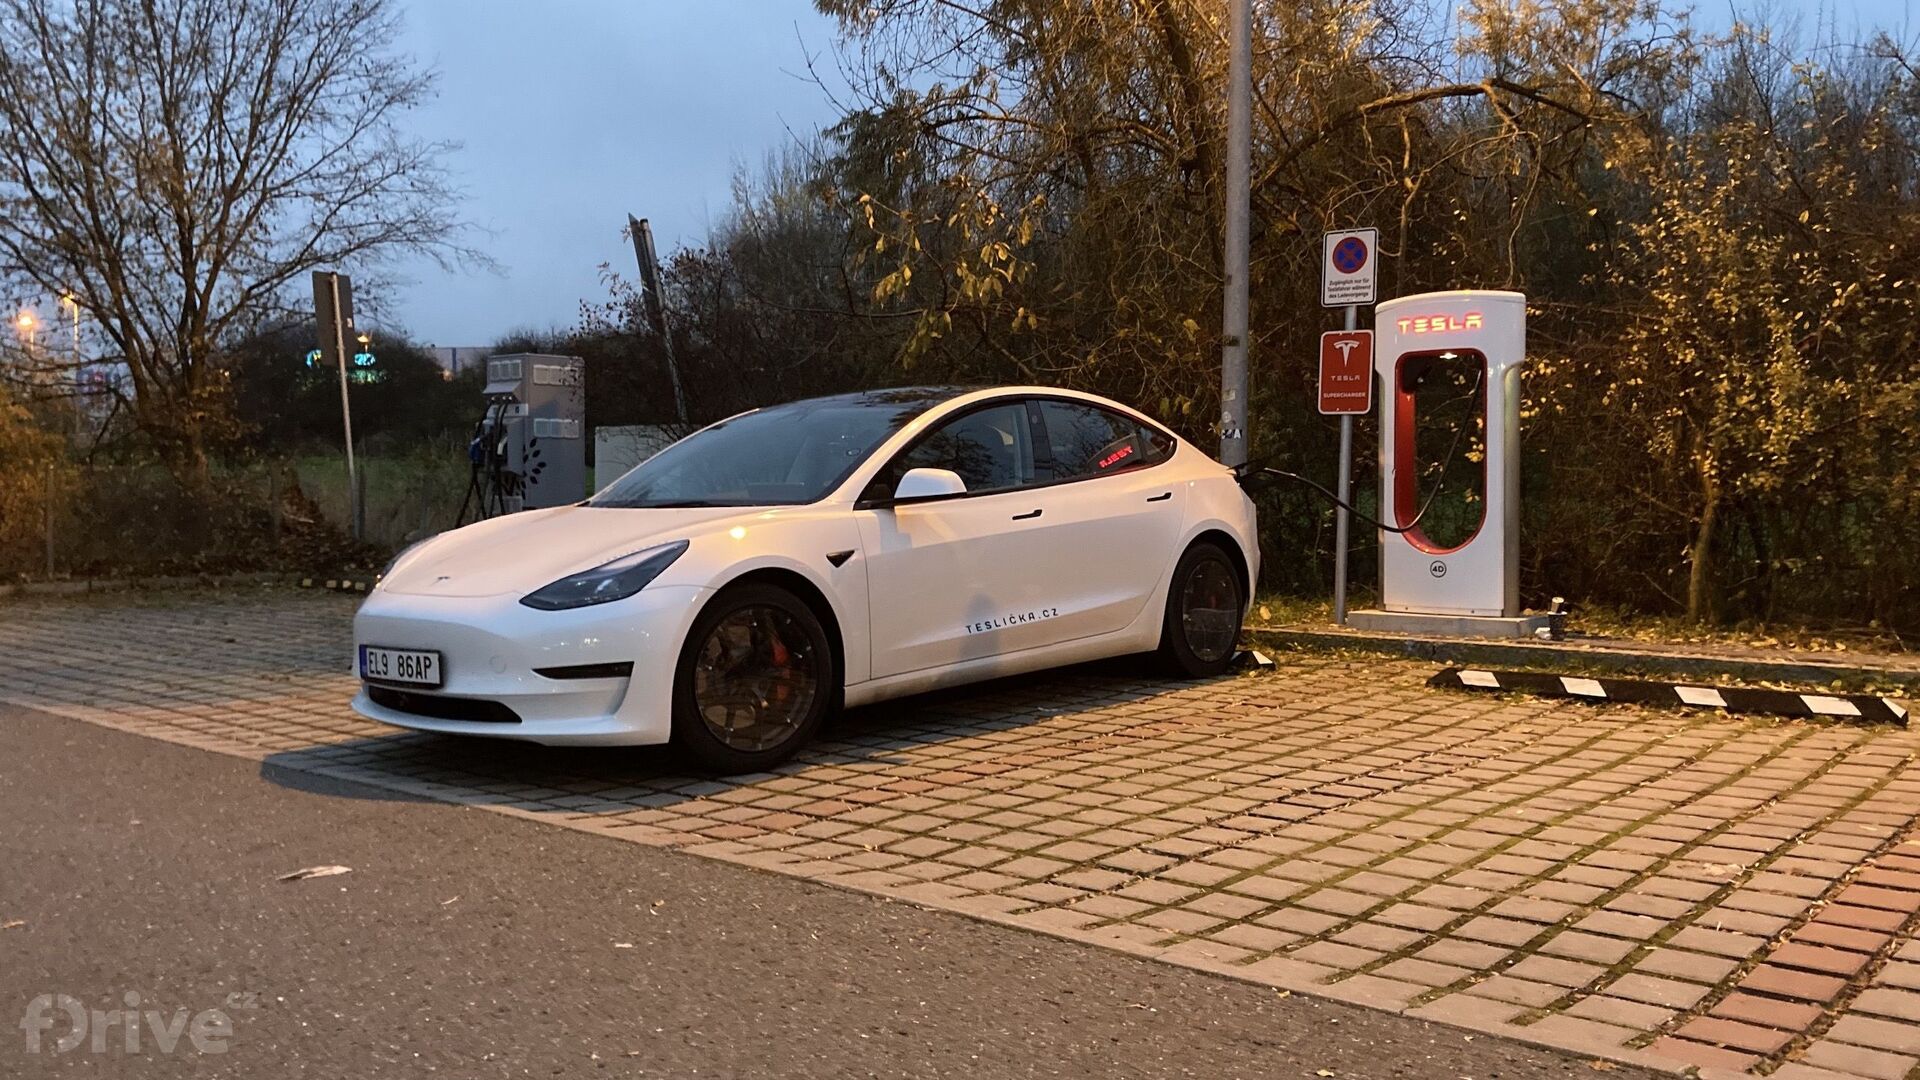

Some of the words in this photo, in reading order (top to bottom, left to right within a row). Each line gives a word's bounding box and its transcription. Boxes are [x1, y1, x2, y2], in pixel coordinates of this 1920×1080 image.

[1397, 313, 1482, 335] TESLA
[1323, 391, 1366, 399] SUPERCHARGER
[1432, 565, 1445, 573] 4D
[966, 608, 1058, 634] TESLIČKA.CZ
[369, 651, 388, 676] EL9
[397, 654, 432, 679] 86AP
